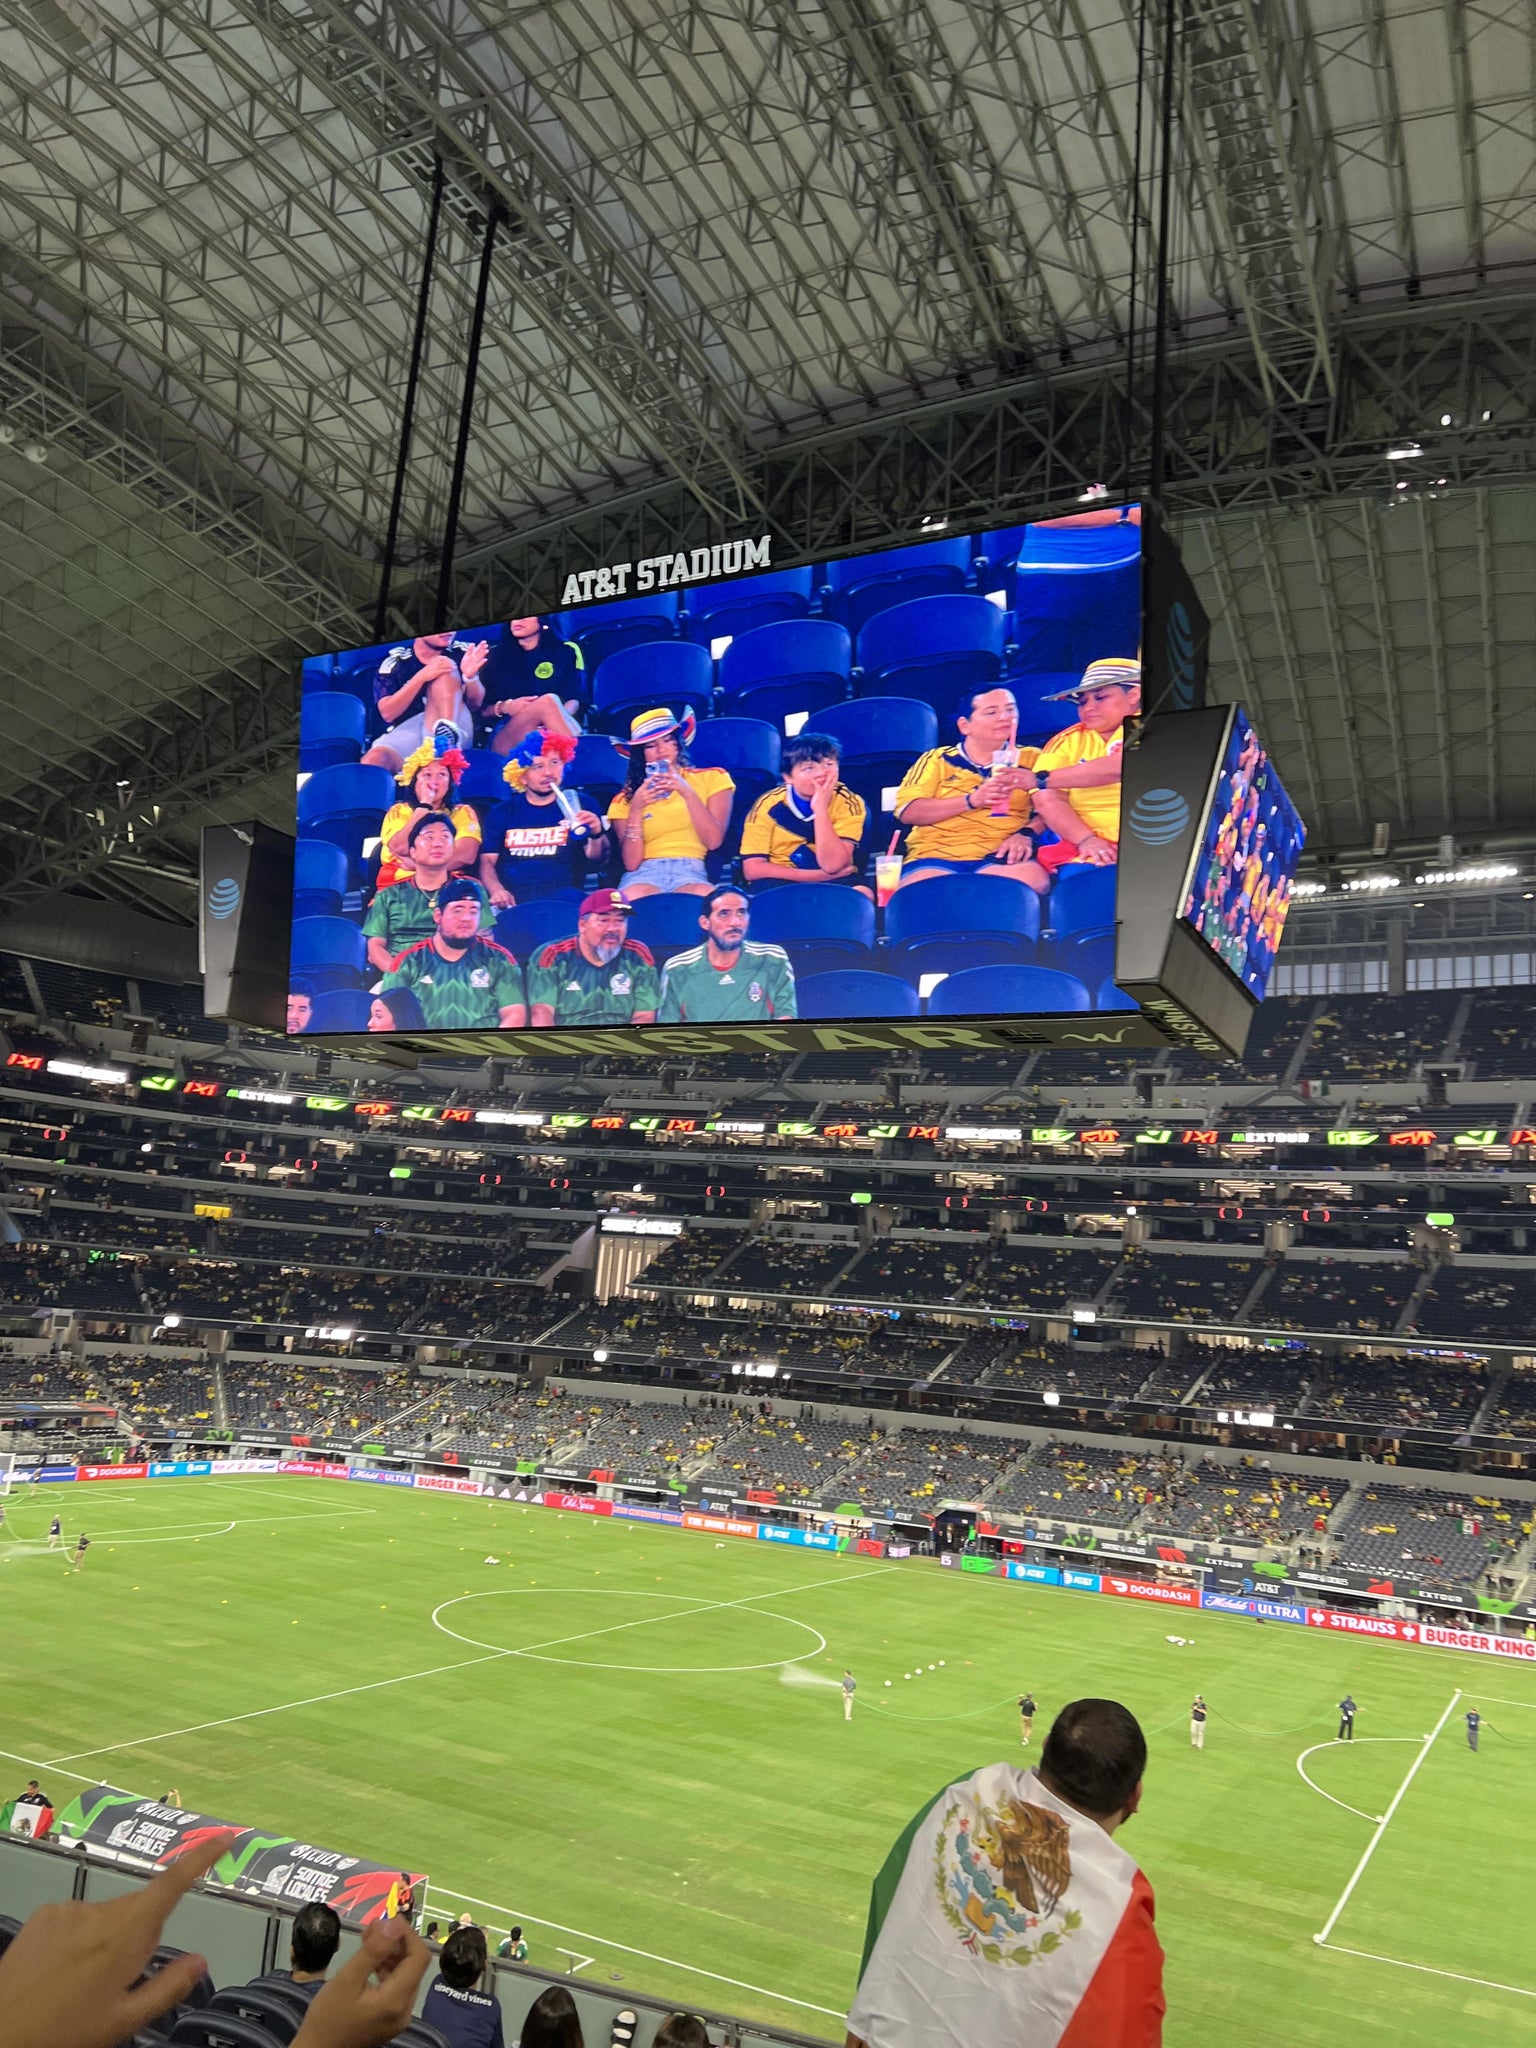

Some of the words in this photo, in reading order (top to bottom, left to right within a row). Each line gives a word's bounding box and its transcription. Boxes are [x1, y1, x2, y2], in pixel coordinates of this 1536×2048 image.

[561, 562, 631, 604] AT&T
[637, 534, 771, 590] STADIUM
[507, 827, 565, 846] HUSTLE
[1143, 999, 1220, 1051] WINSTAR
[405, 1026, 1004, 1056] WINSTAR
[418, 1477, 455, 1490] BURGER
[457, 1481, 478, 1493] KING
[1130, 1585, 1192, 1602] DOORDASH
[1254, 1582, 1281, 1595] AT&T
[1257, 1603, 1301, 1619] ULTRA
[1330, 1614, 1397, 1636] STRAUSS
[1426, 1628, 1491, 1651] BURGER
[1494, 1639, 1536, 1657] KING
[130, 1834, 168, 1857] LOCALES
[284, 1879, 331, 1904] LOCALES
[434, 1982, 469, 2001] vineyard
[468, 1994, 493, 2007] vines
